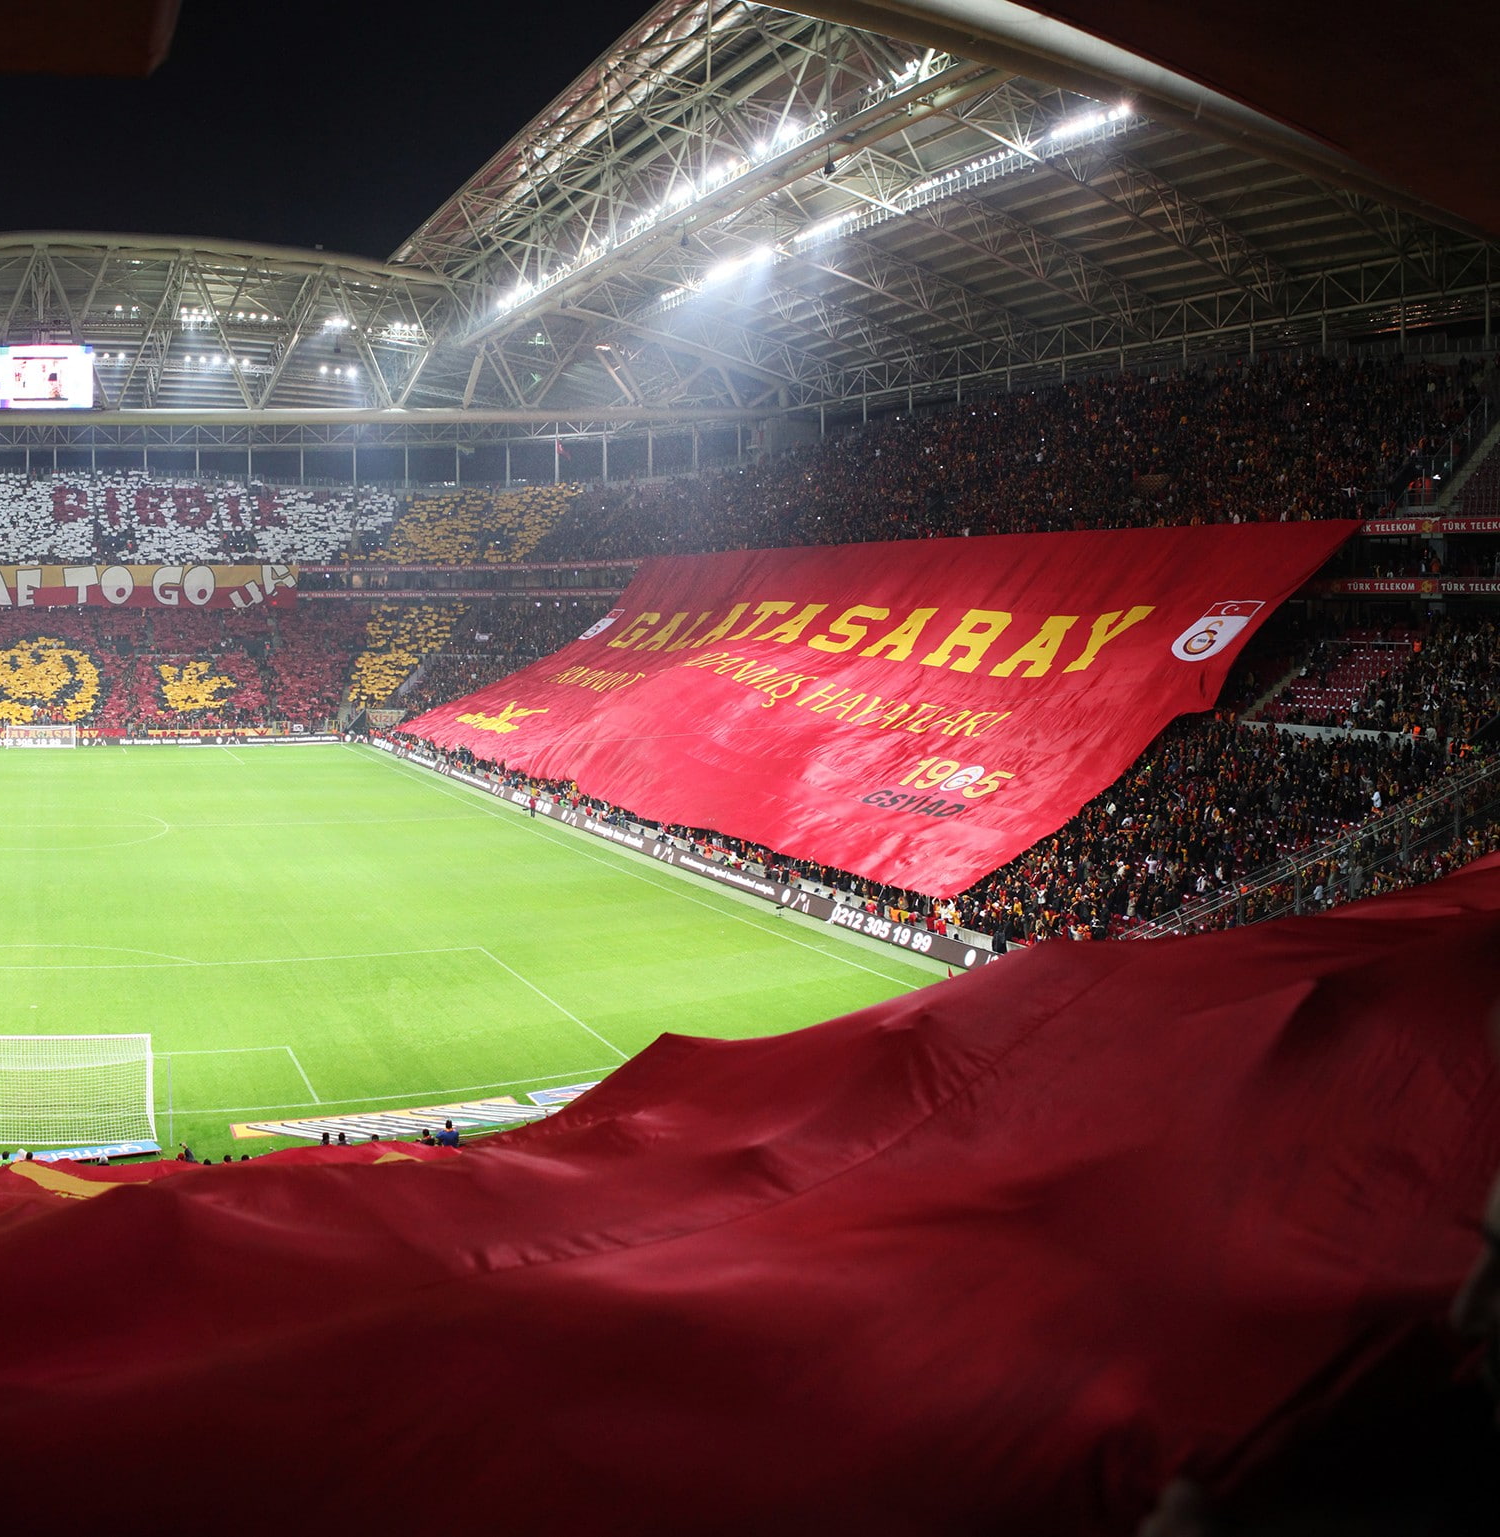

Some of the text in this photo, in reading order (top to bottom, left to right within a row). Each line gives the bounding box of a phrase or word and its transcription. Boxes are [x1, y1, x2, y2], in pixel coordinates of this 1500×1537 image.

[1376, 523, 1416, 532] TELEKOM
[1442, 521, 1500, 530] TÜRK TELEK
[62, 565, 134, 604] TO
[152, 565, 216, 605] GO
[1347, 581, 1415, 591] TÜRK TELEKOM
[1441, 582, 1500, 591] TÜRK TELEKO
[607, 601, 1157, 678] GALATASARAY
[796, 683, 1012, 737] HAYATLAR!
[832, 904, 932, 952] 0212 305 19 99
